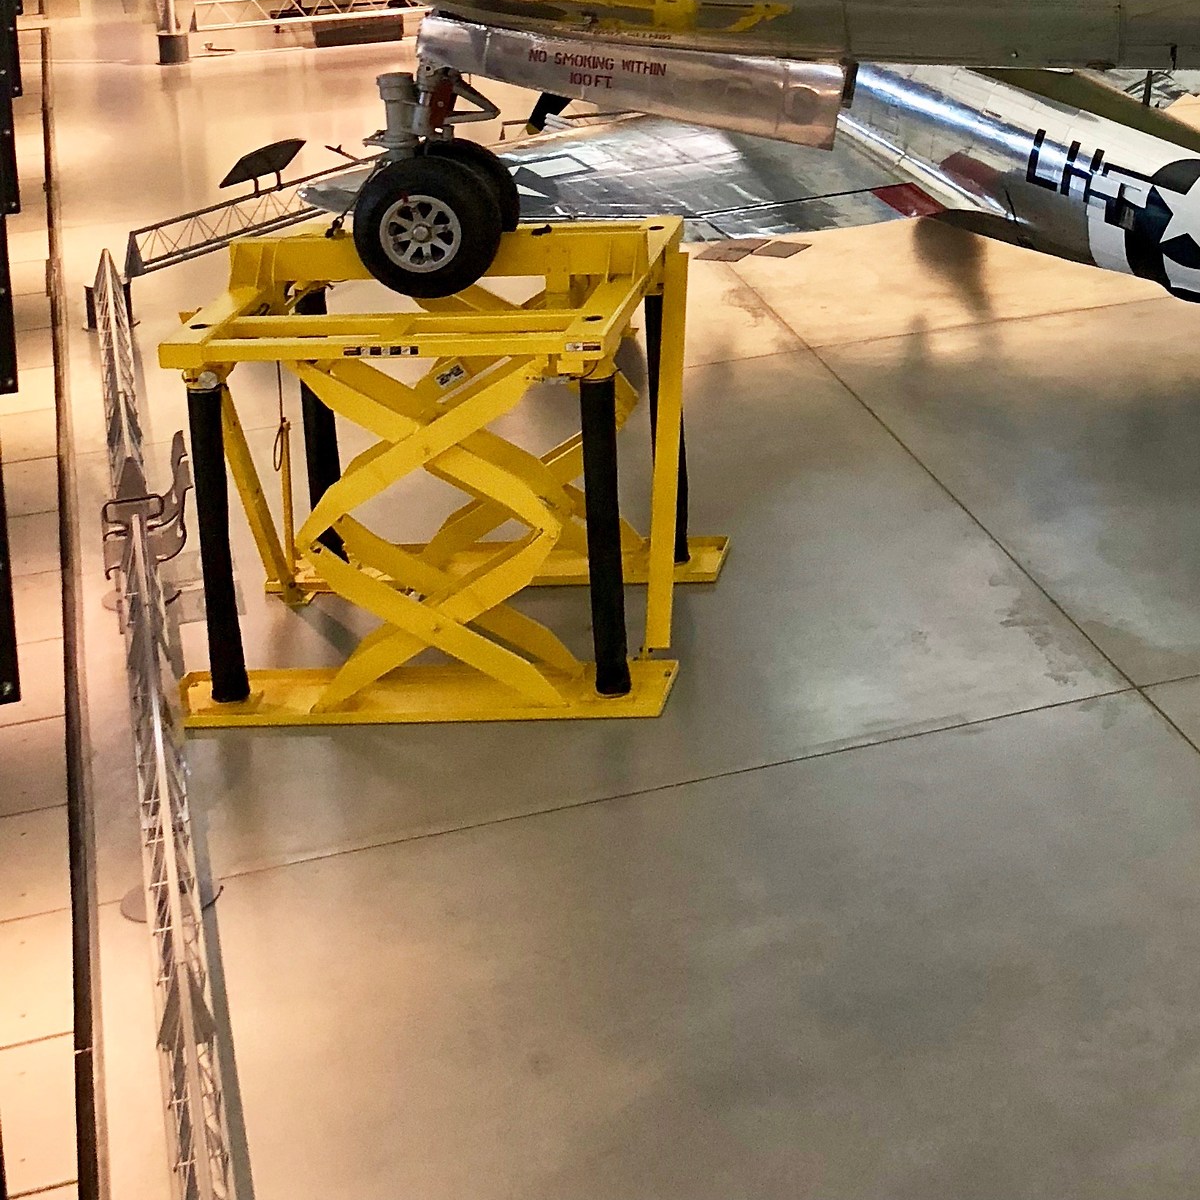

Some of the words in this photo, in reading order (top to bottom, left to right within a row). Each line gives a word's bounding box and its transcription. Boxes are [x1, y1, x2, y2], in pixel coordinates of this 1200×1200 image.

[528, 49, 547, 63] NO
[554, 52, 615, 70] SMOKING
[622, 59, 668, 77] WITHIN
[570, 72, 592, 86] 100
